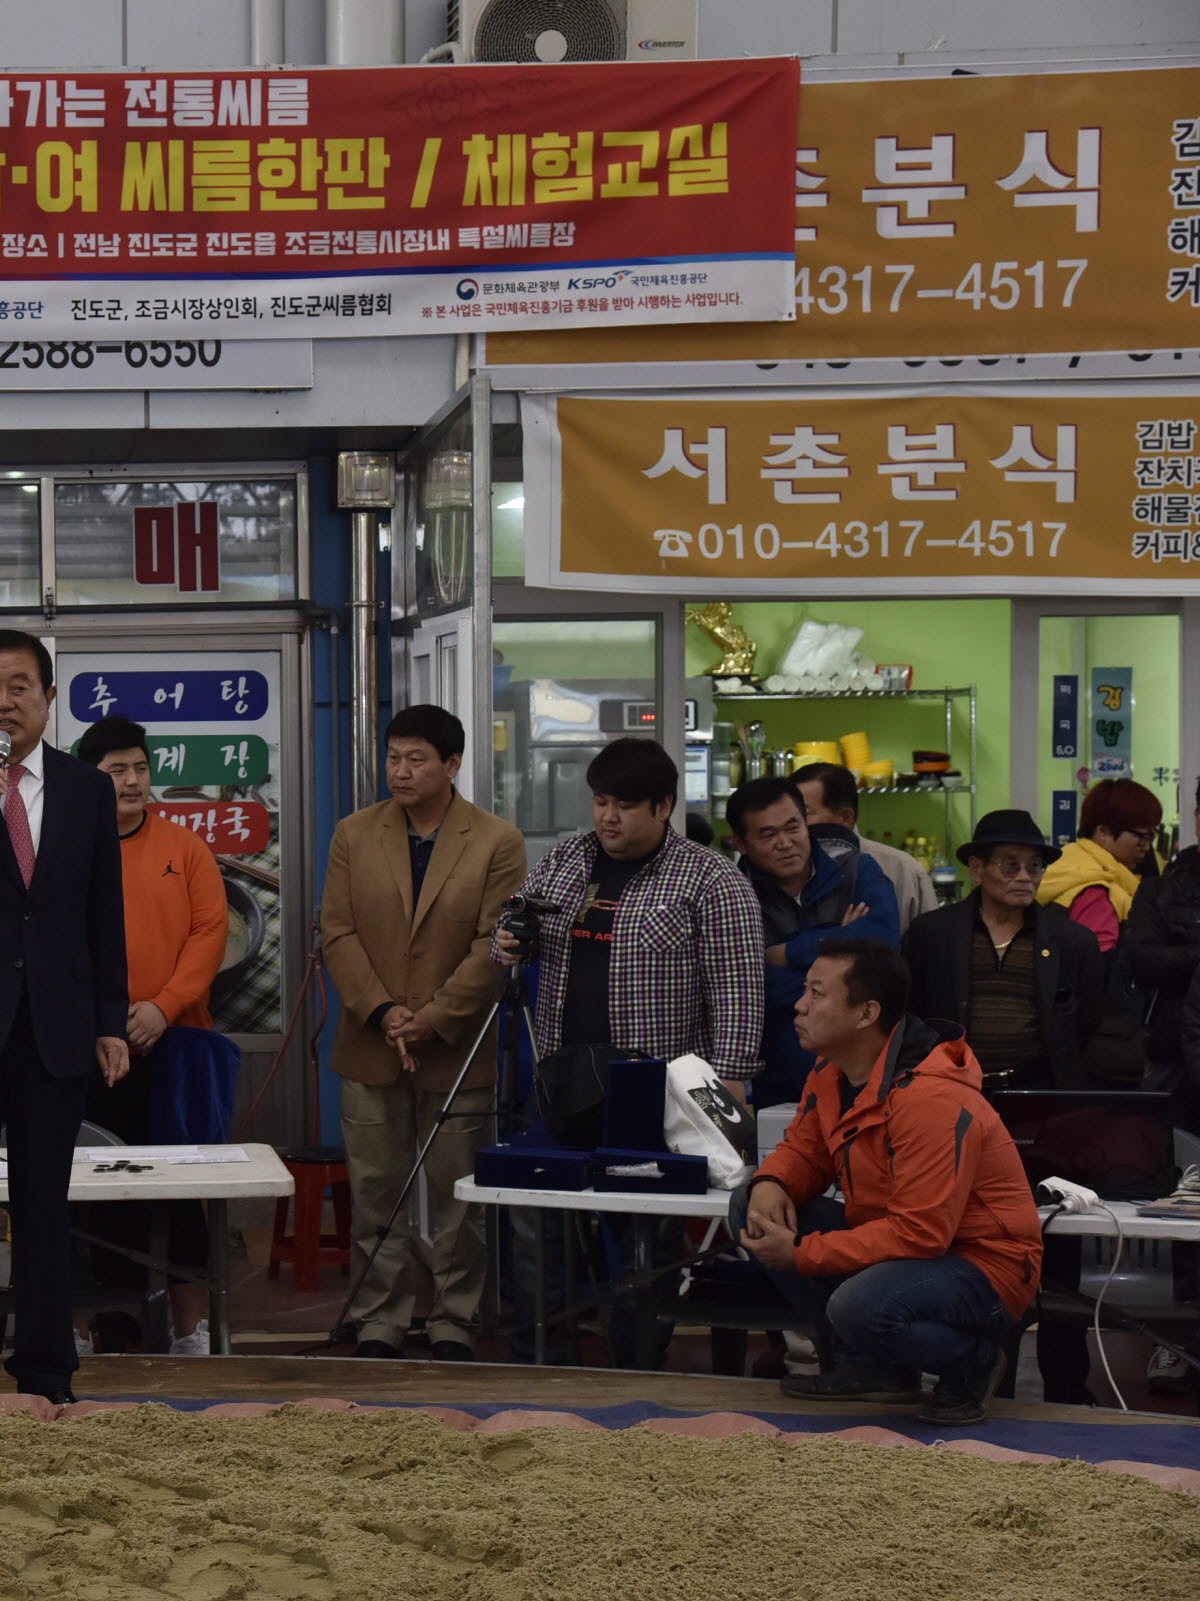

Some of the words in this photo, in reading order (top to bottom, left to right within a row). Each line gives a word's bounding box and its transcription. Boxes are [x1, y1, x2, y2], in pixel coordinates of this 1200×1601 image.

[124, 78, 309, 127] 전통씨름
[120, 136, 391, 213] 씨름한판
[462, 121, 730, 207] 체험교실
[1, 232, 49, 259] 장소
[73, 232, 121, 258] 전남
[127, 232, 199, 258] 진도군
[205, 231, 277, 257] 진도읍
[284, 226, 450, 257] 조금전통시장내
[457, 221, 576, 250] 특설씨름장
[482, 280, 560, 295] 문화체육관광부
[567, 277, 617, 291] KSPO
[630, 272, 708, 287] 국민체육진흥공단
[70, 299, 129, 323] 진도군,
[134, 296, 264, 320] 조금시장상인회,
[269, 293, 392, 318] 진도군씨름협회
[435, 305, 447, 319] 본
[449, 303, 483, 318] 사업은
[485, 299, 574, 316] 국민체육진흥기금
[576, 297, 610, 313] 후원을
[612, 296, 635, 312] 받아
[637, 293, 683, 310] 시행하는
[685, 291, 744, 307] 사업입니다.
[1137, 420, 1195, 451] 김밥
[1135, 457, 1200, 488] 잔치
[699, 519, 1068, 561] 010-4317-4517
